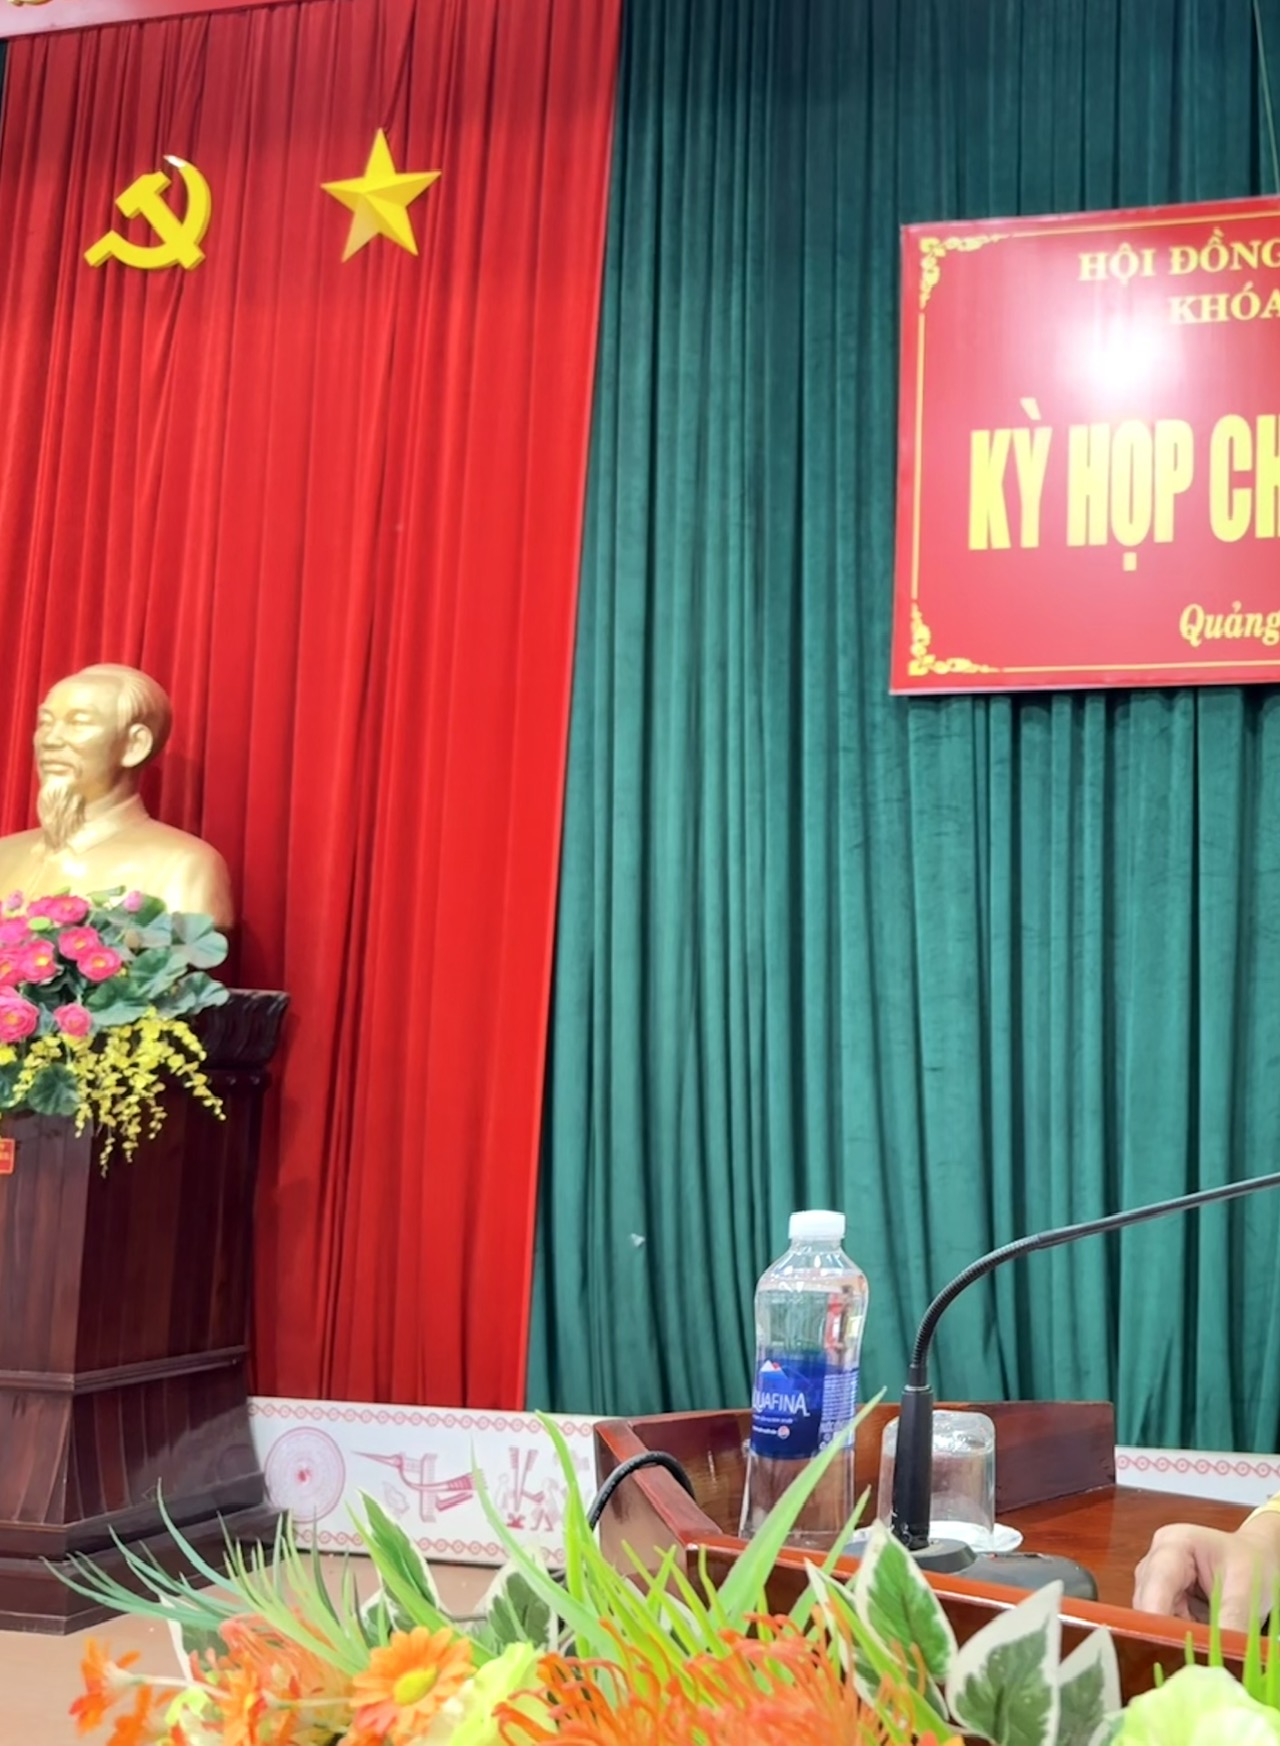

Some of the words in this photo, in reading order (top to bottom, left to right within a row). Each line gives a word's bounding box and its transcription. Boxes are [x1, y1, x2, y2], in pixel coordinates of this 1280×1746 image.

[1077, 241, 1156, 286] HỘI
[968, 397, 1053, 550] KỲ
[1066, 418, 1194, 572] HỌP
